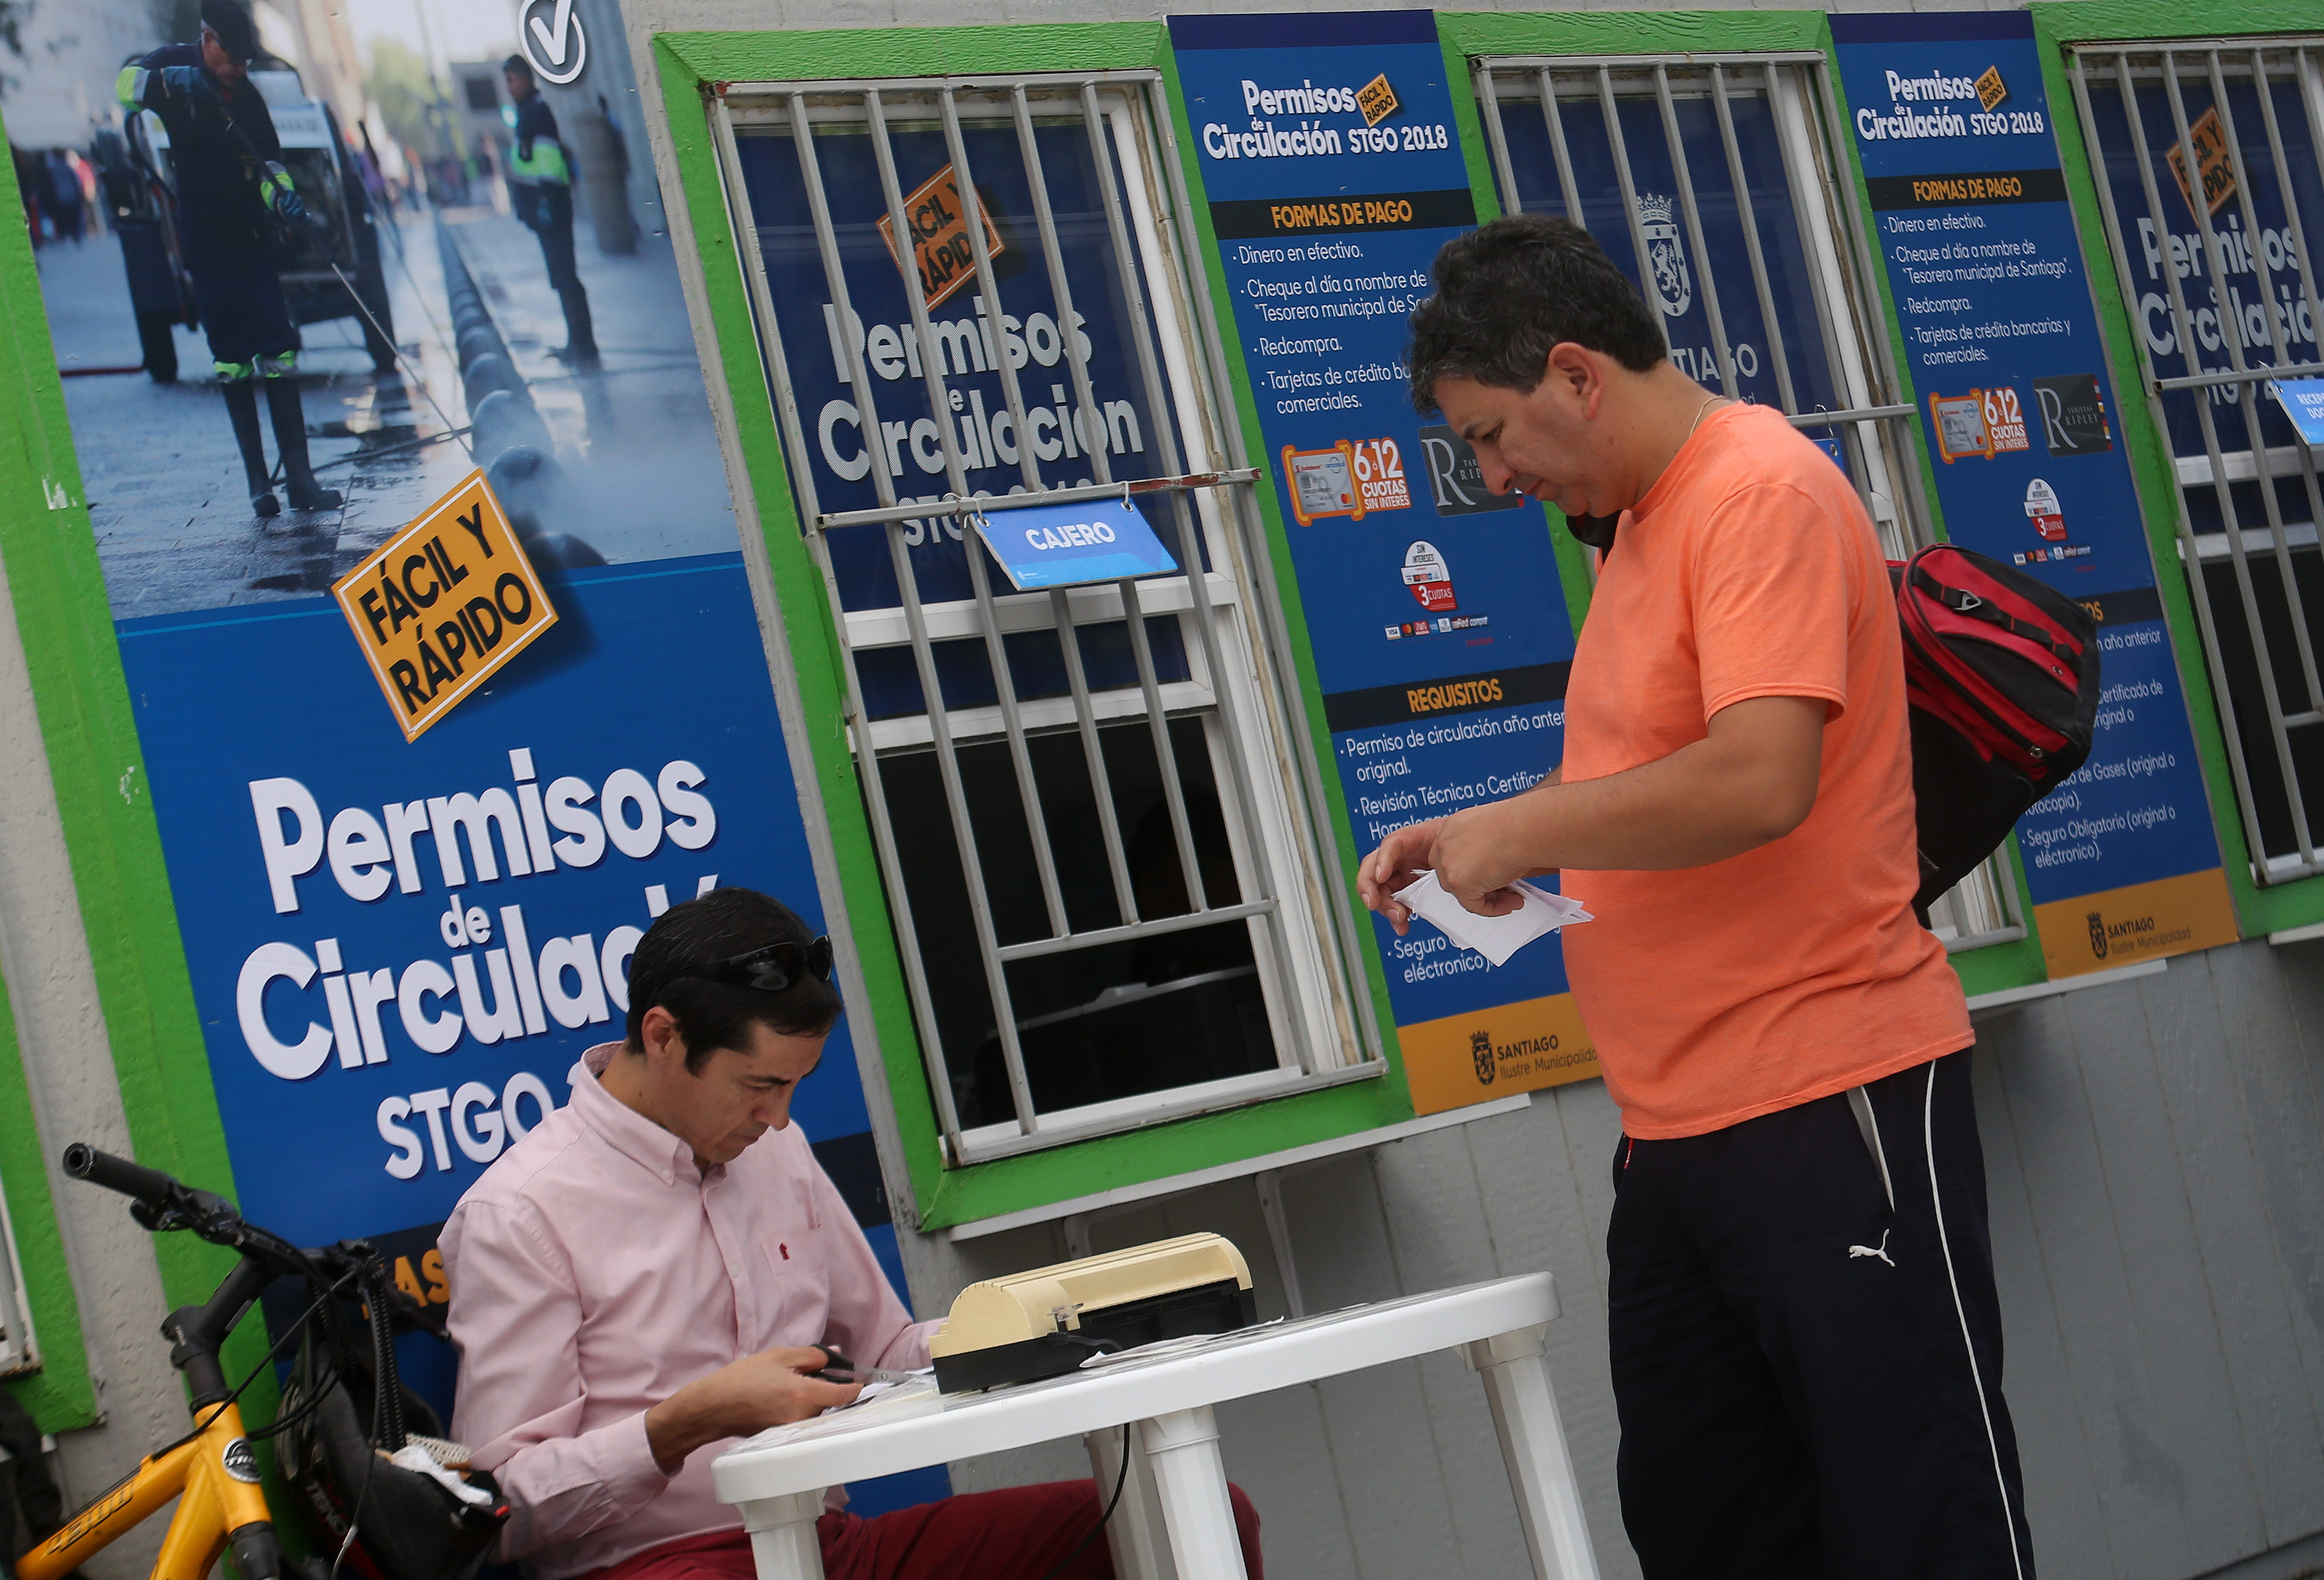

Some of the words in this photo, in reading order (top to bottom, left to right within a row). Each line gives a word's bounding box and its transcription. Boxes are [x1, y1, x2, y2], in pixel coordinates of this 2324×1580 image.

[1241, 79, 1356, 116] Permisos
[1378, 80, 1385, 92] Y
[1885, 70, 1976, 102] Permisos
[1365, 95, 1393, 123] RÁPIDO
[1894, 102, 1906, 115] de
[1251, 117, 1265, 131] de
[1856, 106, 1967, 141] Circulación
[1970, 113, 2009, 136] STGO
[2010, 111, 2045, 133] 2018
[2206, 121, 2221, 147] Y
[1203, 120, 1342, 159] Circulación
[1348, 127, 1398, 153] STGO
[1403, 124, 1449, 151] 2018
[1912, 179, 1969, 202] FORMAS
[1969, 179, 1987, 199] DE
[1988, 176, 2022, 198] PAGO
[1270, 203, 1341, 229] FORMAS
[1340, 202, 1364, 225] DE
[1364, 199, 1413, 224] PAGO
[1888, 216, 1925, 233] Dinero
[1927, 218, 1941, 231] en
[1943, 212, 1987, 230] efectivo.
[1239, 245, 1285, 264] Dinero
[1287, 248, 1305, 262] en
[1308, 241, 1364, 261] efectivo.
[1895, 245, 1940, 265] Cheque
[1941, 243, 1951, 260] al
[1953, 242, 1970, 259] día
[1971, 245, 1979, 258] a
[1980, 240, 2021, 257] nombre
[2022, 238, 2036, 255] de
[1246, 278, 1302, 301] Cheque
[1305, 275, 1318, 294] al
[1320, 274, 1342, 293] día
[1343, 278, 1352, 292] a
[1354, 272, 1407, 291] nombre
[1409, 269, 1427, 288] de
[1902, 266, 1954, 285] "Tesorero
[1956, 262, 2004, 284] municipal
[2006, 261, 2021, 277] de
[1255, 302, 1319, 322] "Tesorero
[1322, 297, 1386, 320] municipal
[1388, 295, 1405, 314] de
[1907, 297, 1973, 316] Redcompra.
[1914, 325, 1958, 347] Tarjetas
[1959, 323, 1973, 340] de
[1974, 320, 2011, 338] crédito
[2012, 317, 2063, 337] bancarias
[2063, 320, 2071, 337] y
[1259, 336, 1343, 357] Redcompra.
[1923, 345, 1989, 366] comerciales.
[1267, 370, 1322, 393] Tarjetas
[1325, 366, 1343, 385] de
[1345, 362, 1391, 384] crédito
[1276, 391, 1362, 414] comerciales.
[1984, 391, 1999, 426] 6
[1996, 389, 2023, 423] 12
[818, 381, 1143, 481] Crculación
[2035, 388, 2079, 449] R
[2065, 413, 2098, 426] RIPLEY
[1991, 425, 2026, 440] CUOTAS
[1994, 440, 2004, 451] SIN
[1354, 443, 1372, 481] 6
[1370, 440, 1404, 479] 12
[1421, 438, 1476, 507] R
[1459, 468, 1482, 480] RIP
[1361, 479, 1407, 498] CUOTAS
[1364, 498, 1379, 510] SIN
[1380, 494, 1410, 508] INTERES
[1025, 522, 1115, 550] CAJERO
[2037, 517, 2047, 536] 3
[1416, 544, 1426, 554] SIN
[358, 536, 469, 646] FÁCIL
[456, 502, 493, 559] Y
[1418, 585, 1430, 606] 3
[1428, 588, 1453, 601] CUOTAS
[389, 573, 531, 716] RÁPIDO
[2105, 633, 2124, 651] año
[2125, 628, 2161, 649] anterior
[1407, 678, 1503, 713] REQUISITOS
[2150, 678, 2164, 696] de
[2127, 709, 2135, 722] o
[1346, 733, 1404, 758] Permiso
[1407, 729, 1425, 748] de
[1427, 717, 1501, 745] circulación
[1503, 715, 1529, 733] año
[1532, 710, 1565, 730] anter
[1357, 756, 1411, 785] original.
[2078, 766, 2092, 784] de
[2093, 761, 2127, 781] Gases
[2127, 751, 2168, 779] (original
[2168, 754, 2175, 768] o
[1360, 791, 1417, 817] Revisión
[1417, 782, 1474, 808] Técnica
[1476, 783, 1486, 797] o
[249, 748, 717, 913] Permisos
[2027, 827, 2066, 849] Seguro
[2068, 813, 2125, 840] Obligatorio
[2127, 805, 2168, 832] (original
[2168, 806, 2176, 821] o
[440, 894, 492, 947] de
[2108, 917, 2155, 939] SANTIAGO
[1394, 936, 1446, 961] Seguro
[2111, 937, 2135, 954] Ilustre
[2137, 926, 2191, 948] Municipalidad
[1497, 1035, 1559, 1061] SANTIAGO
[1500, 1061, 1530, 1080] Ilustre
[1534, 1048, 1598, 1075] Municipalida
